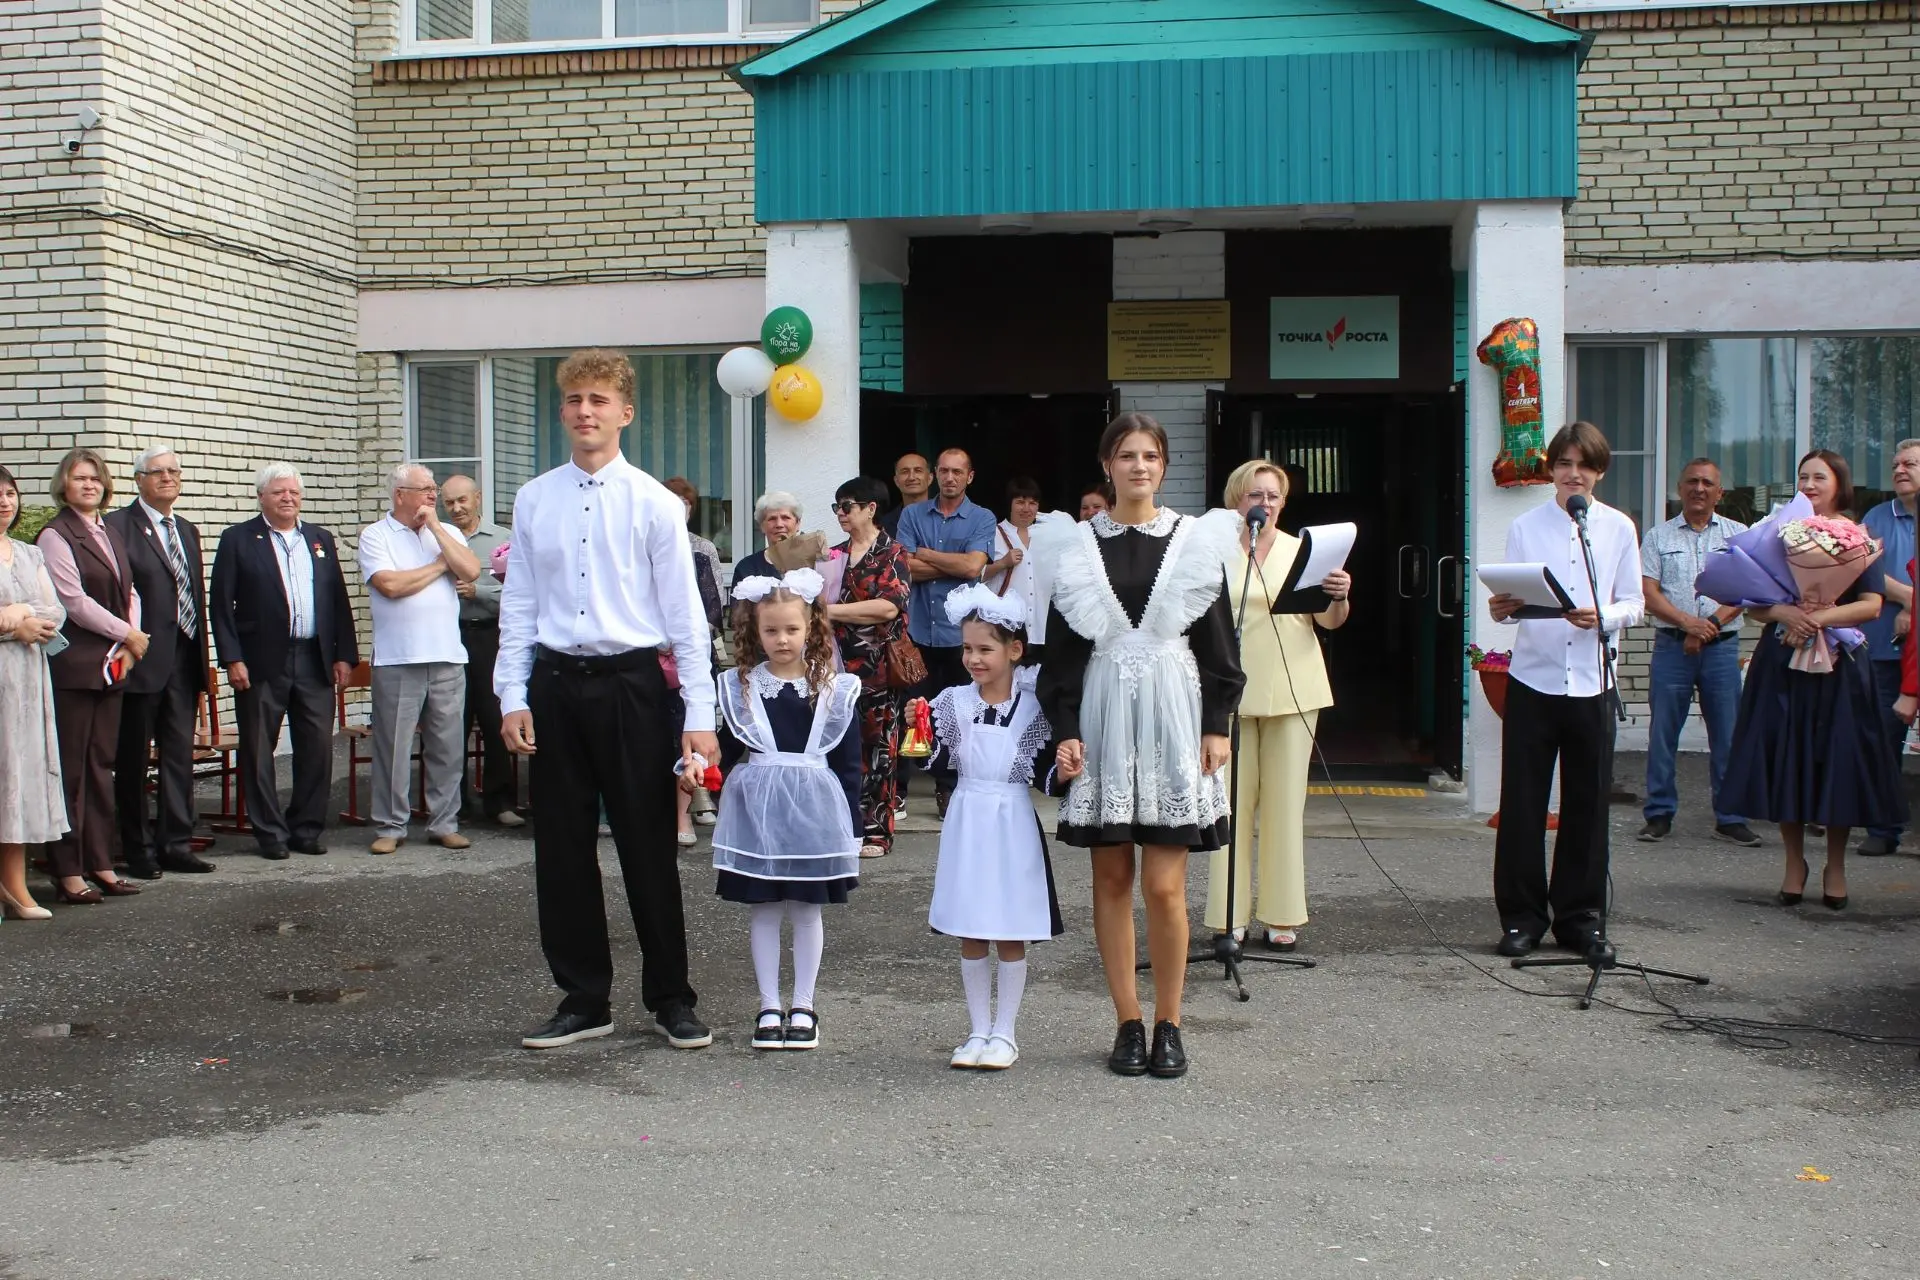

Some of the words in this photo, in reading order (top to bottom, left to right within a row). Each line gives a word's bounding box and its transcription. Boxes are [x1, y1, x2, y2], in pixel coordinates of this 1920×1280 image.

[770, 337, 788, 348] Пора
[1278, 332, 1322, 342] ТОЧКА
[1345, 332, 1388, 342] РОСТА
[1517, 382, 1525, 397] 1
